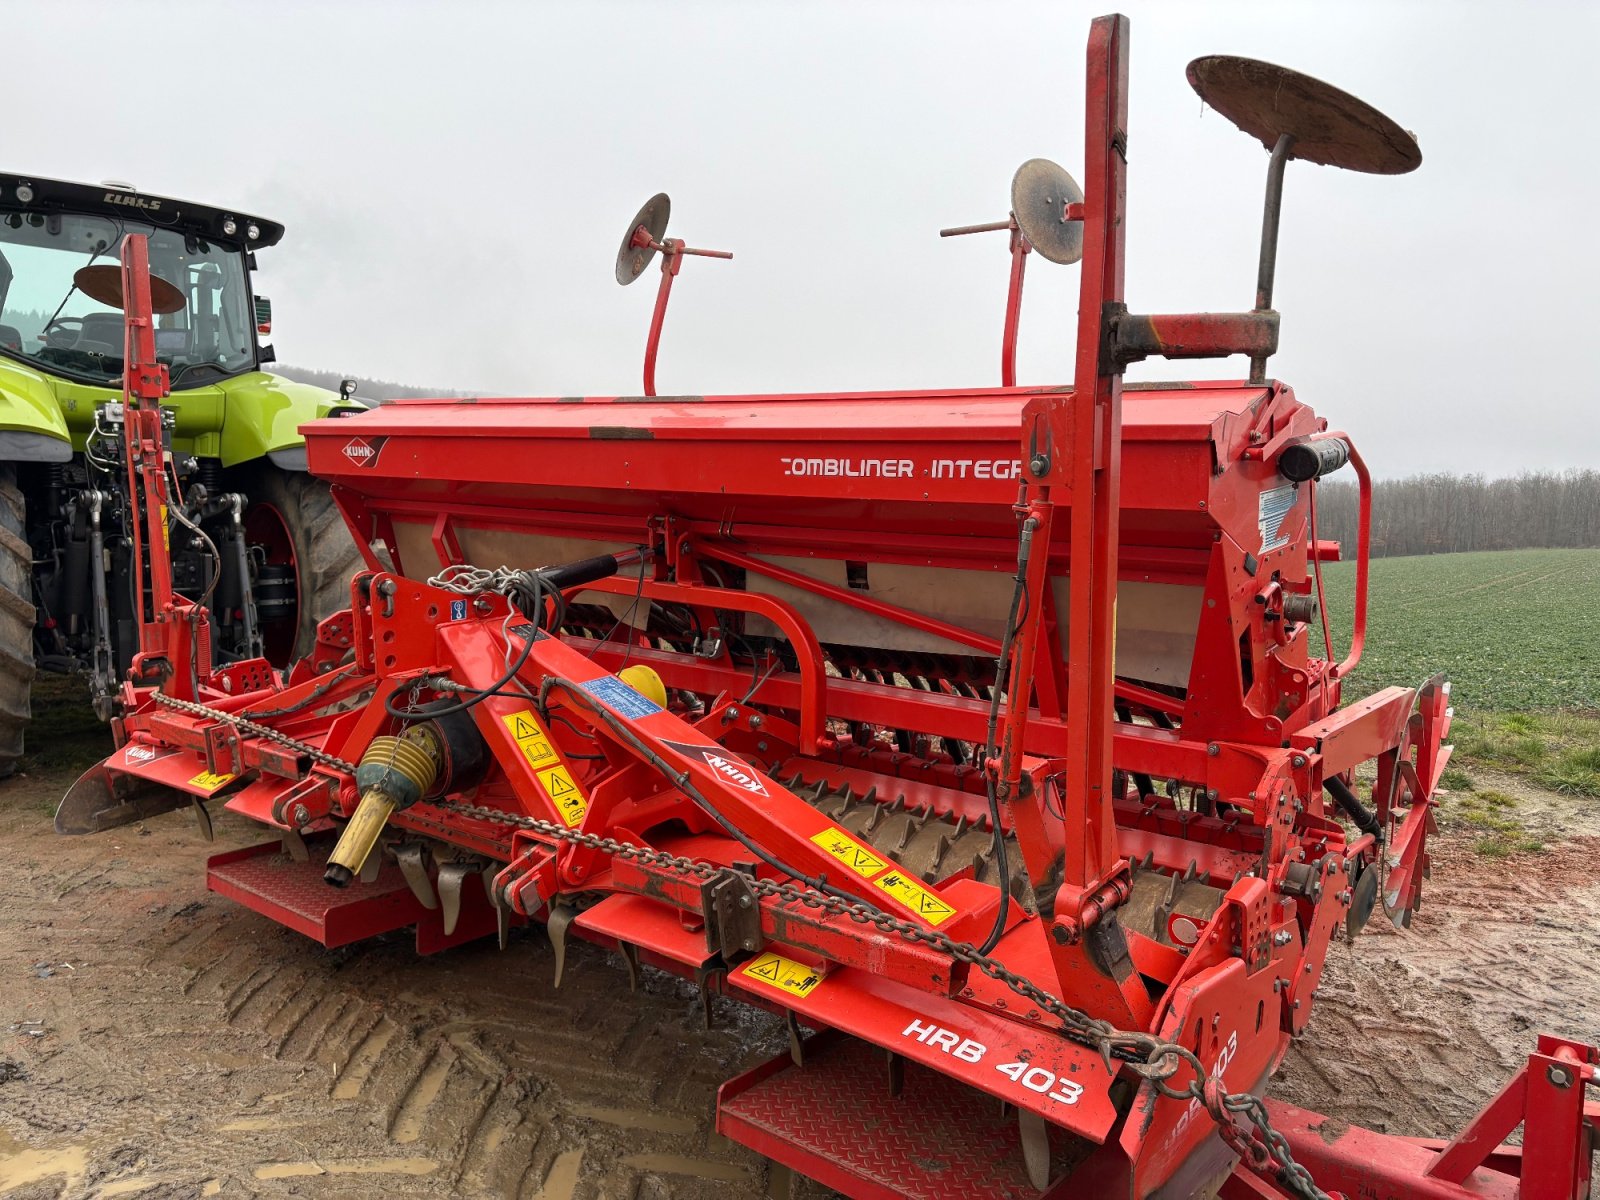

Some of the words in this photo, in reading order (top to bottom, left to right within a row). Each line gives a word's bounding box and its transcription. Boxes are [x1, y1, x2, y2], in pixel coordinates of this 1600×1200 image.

[103, 193, 161, 210] CLAAS
[346, 446, 370, 457] KUHN
[127, 747, 153, 760] KUHN
[708, 757, 763, 791] KUHN
[901, 1019, 987, 1063] HRB
[995, 1061, 1084, 1105] 403
